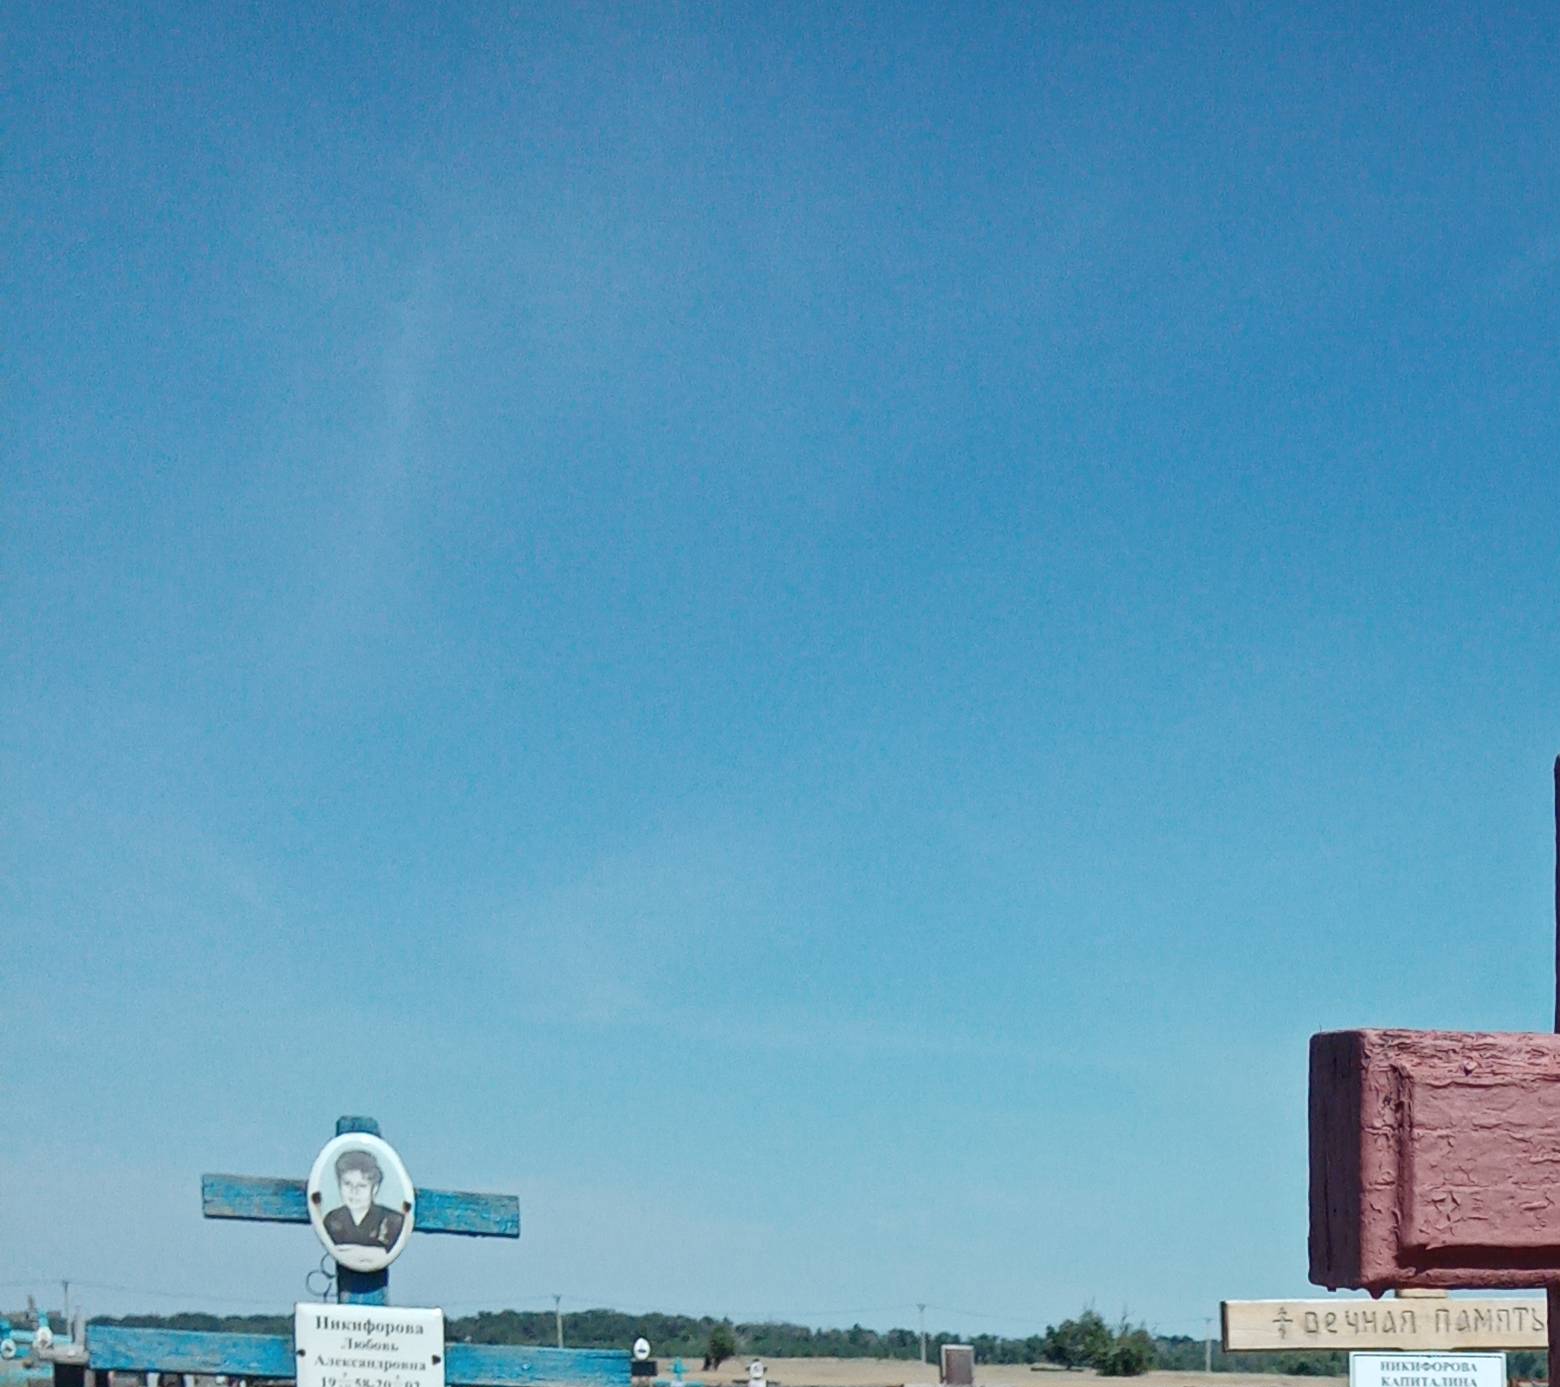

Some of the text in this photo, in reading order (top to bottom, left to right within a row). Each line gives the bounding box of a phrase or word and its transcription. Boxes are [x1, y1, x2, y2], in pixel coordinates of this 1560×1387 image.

[315, 1315, 424, 1337] Никифорова
[341, 1337, 399, 1352] Любовь
[314, 1354, 427, 1372] Александровна
[1380, 1360, 1478, 1373] НИКИФОРОВА
[1381, 1376, 1478, 1387] КАПИТАЛИНА
